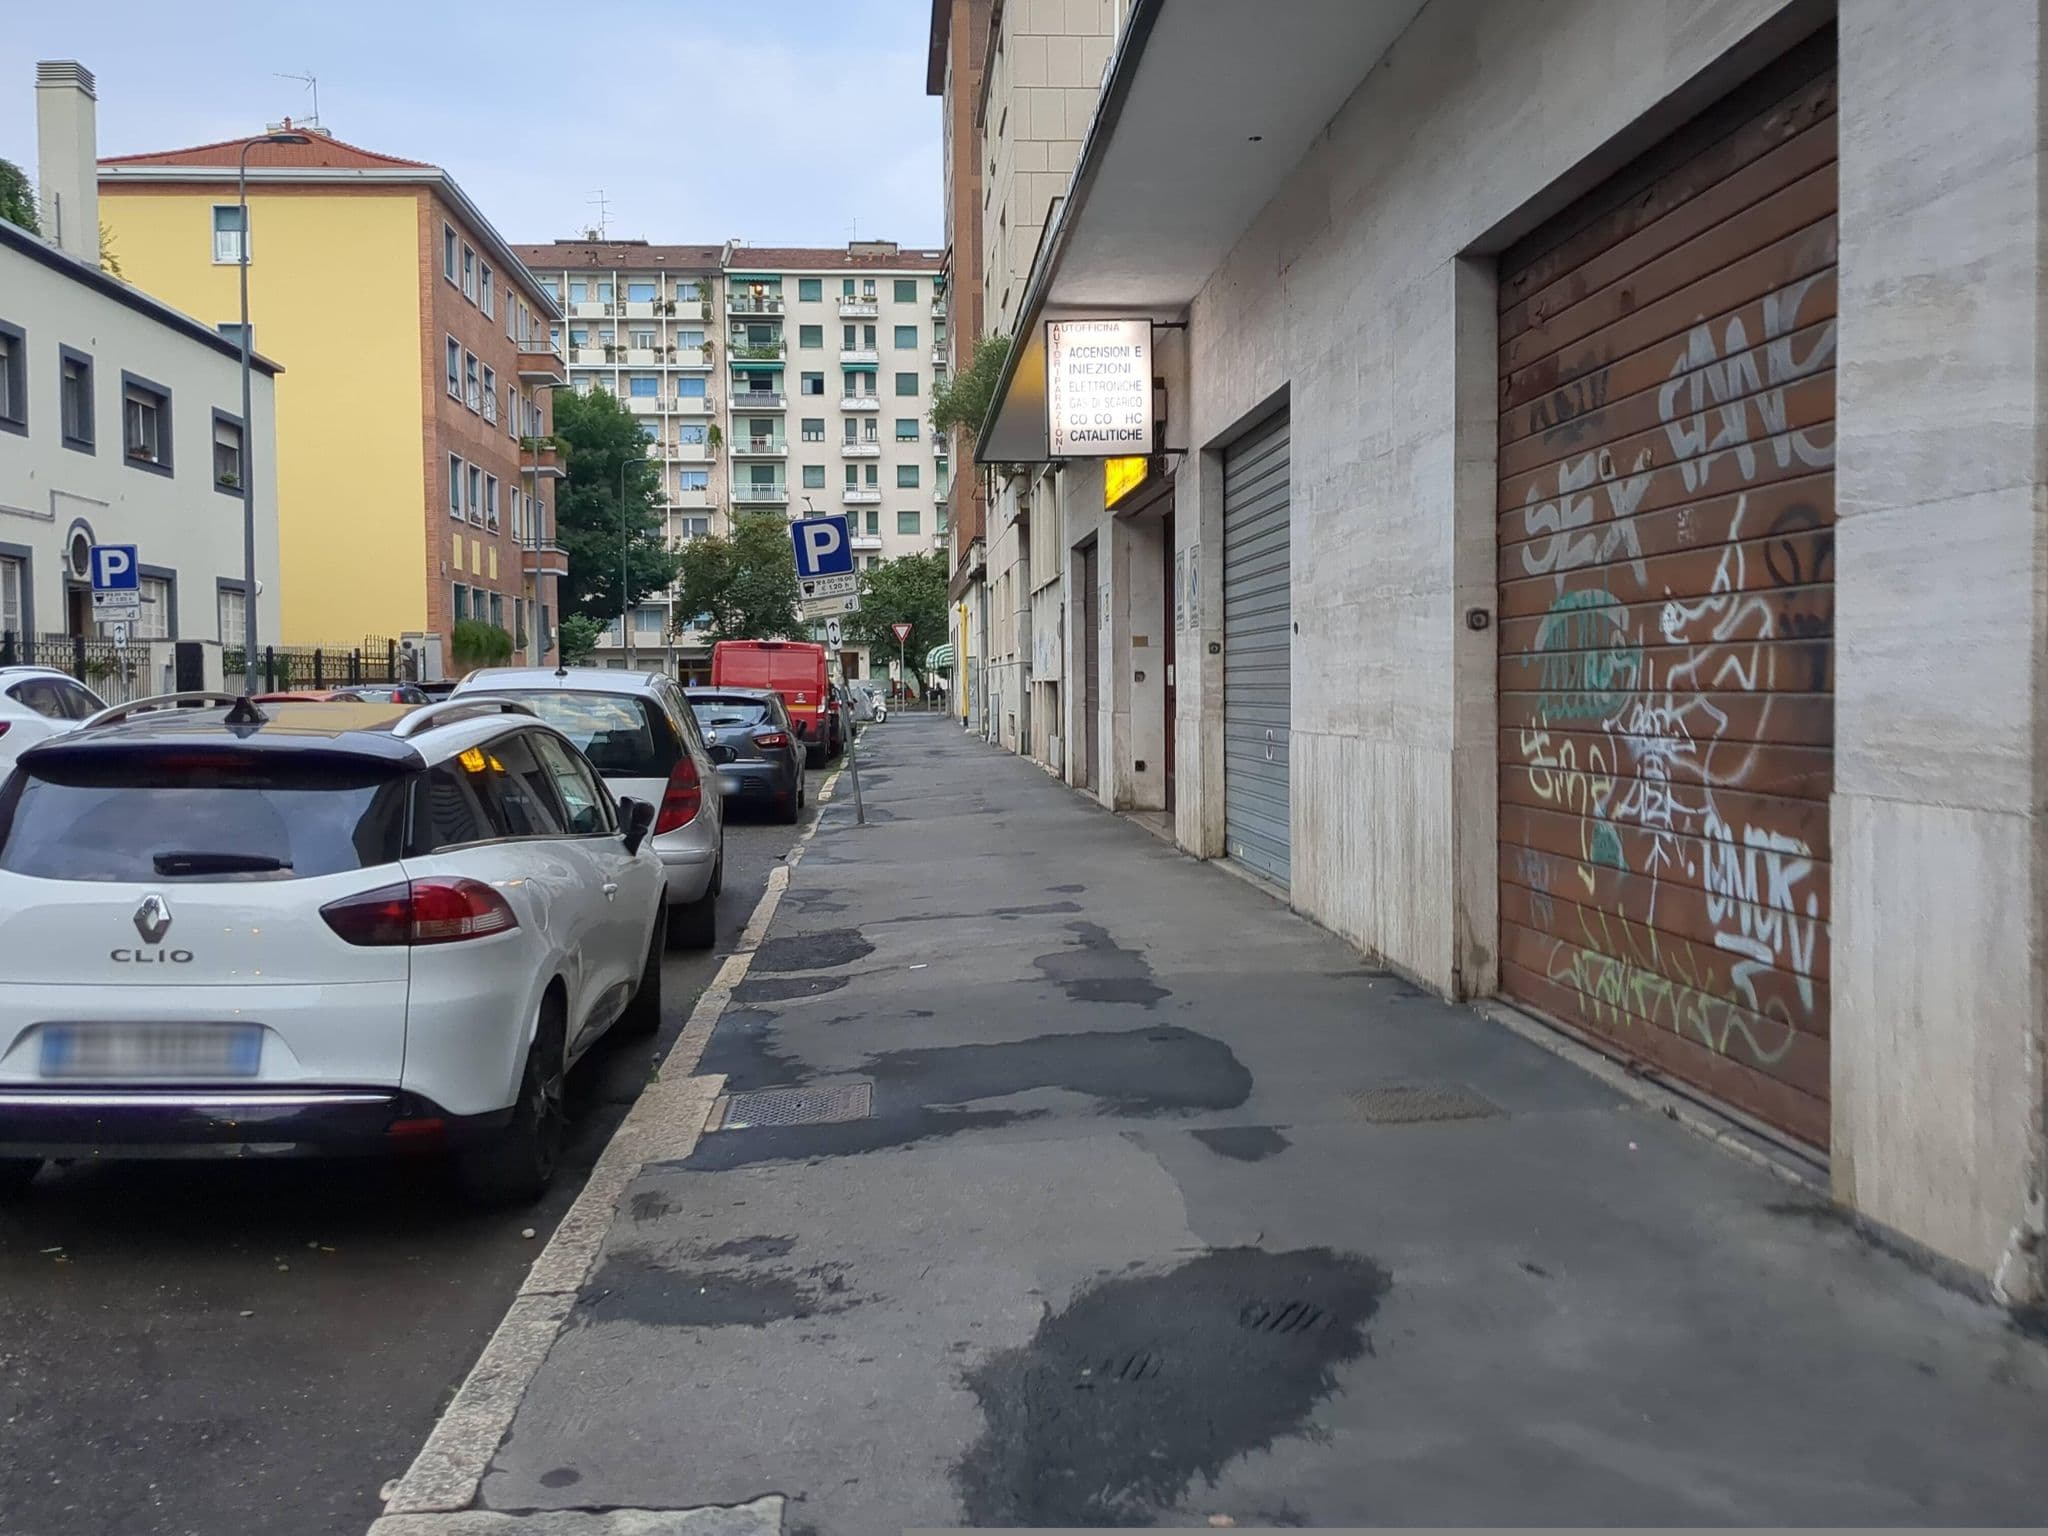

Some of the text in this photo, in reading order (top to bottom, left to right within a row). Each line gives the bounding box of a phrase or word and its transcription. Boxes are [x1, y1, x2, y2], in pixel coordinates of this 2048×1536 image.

[1069, 345, 1142, 358] ACCENSIONI E
[1069, 363, 1131, 375] INIEZIONI
[1069, 380, 1142, 392] ELETTRONICHE
[1105, 396, 1143, 409] SCARICO
[1070, 412, 1143, 426] CO CO HC
[1070, 428, 1142, 441] CATALITICHE
[1521, 447, 1654, 596] SEX
[803, 524, 840, 572] P
[100, 549, 130, 587] P
[111, 949, 194, 963] CLIO
